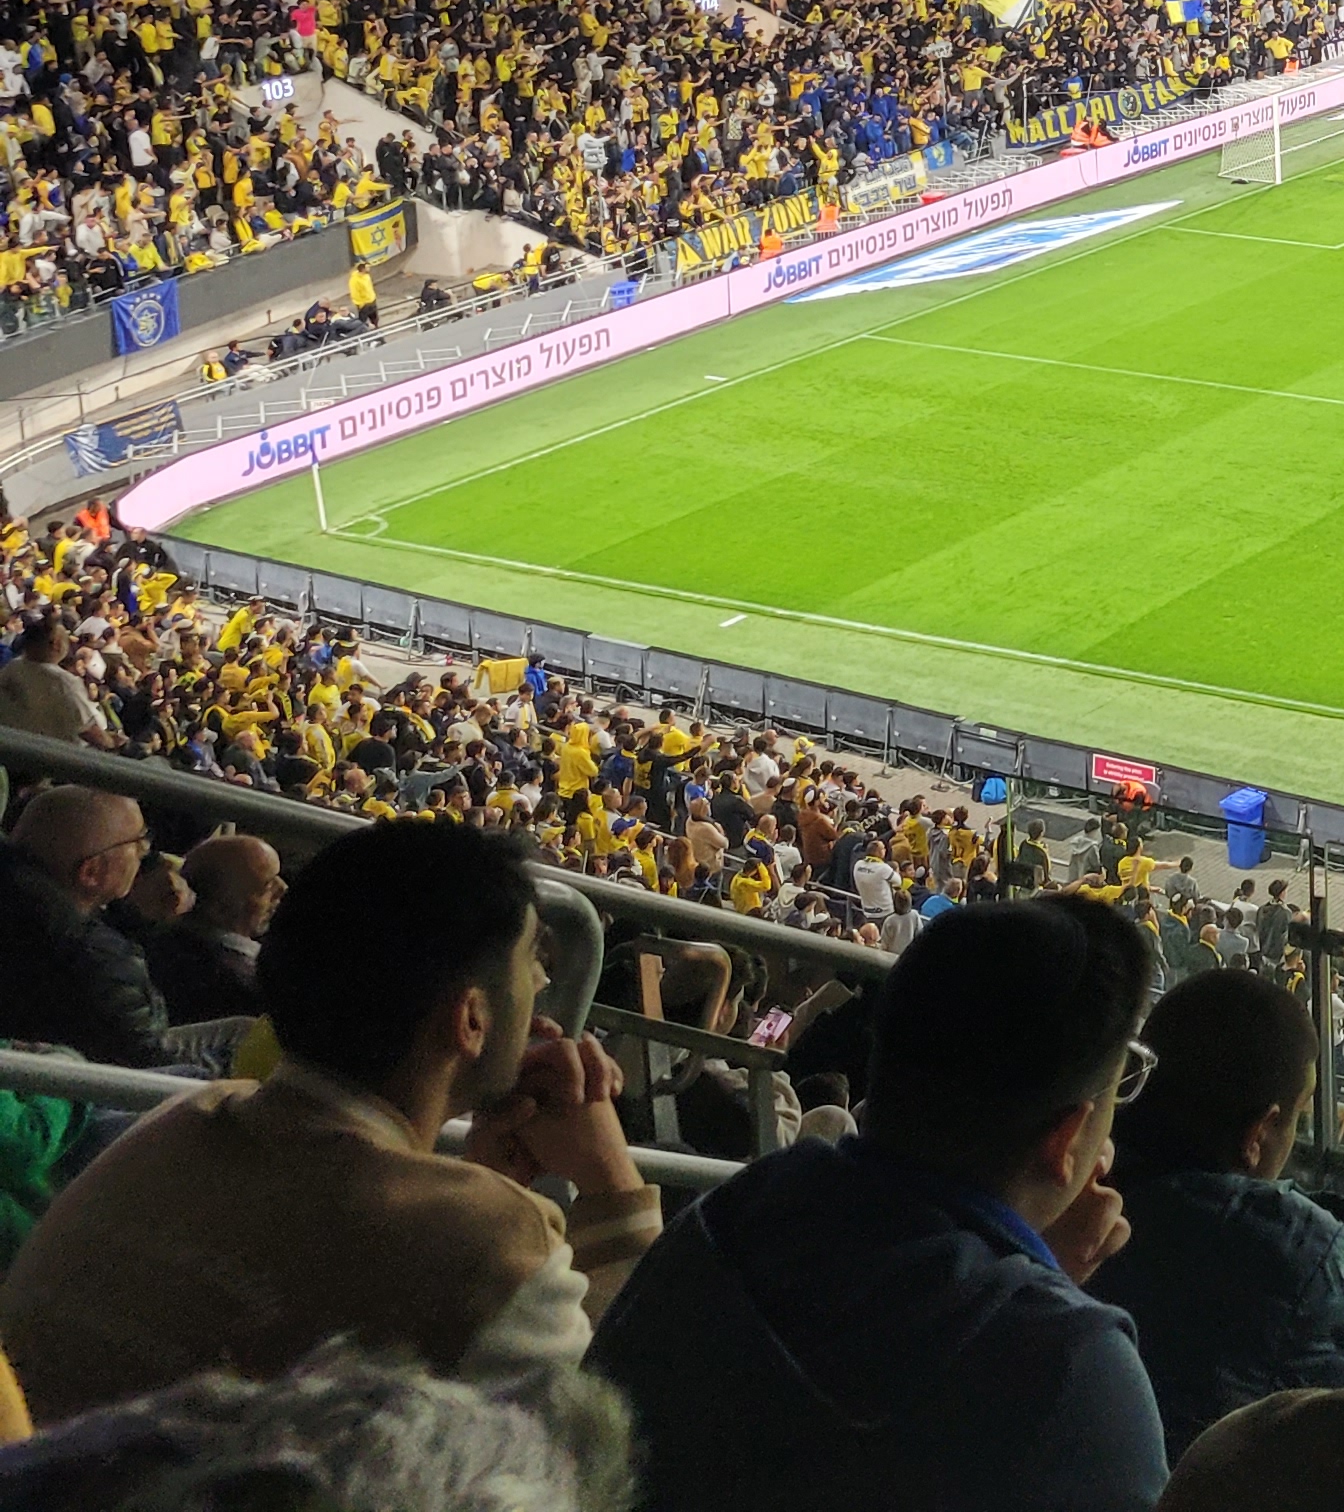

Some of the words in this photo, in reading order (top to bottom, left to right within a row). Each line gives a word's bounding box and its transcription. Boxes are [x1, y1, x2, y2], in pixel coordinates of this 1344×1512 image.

[262, 78, 295, 101] 103
[1278, 90, 1316, 118] תפעול
[1006, 94, 1116, 145] MACCABI
[1173, 120, 1226, 150] פנסיונים
[1231, 104, 1273, 132] מוצרים
[1123, 138, 1170, 168] JOBBIT
[964, 186, 1013, 221] תפעול
[697, 215, 753, 260] WAR
[754, 193, 817, 239] ZONE
[903, 208, 958, 243] מוצרים
[828, 228, 897, 269] פנסיונים
[763, 254, 823, 293] JOBBIT
[539, 326, 611, 370] תפעול
[450, 353, 532, 402] מוצרים
[338, 386, 442, 441] פנסיונים
[241, 423, 332, 477] JOBBIT
